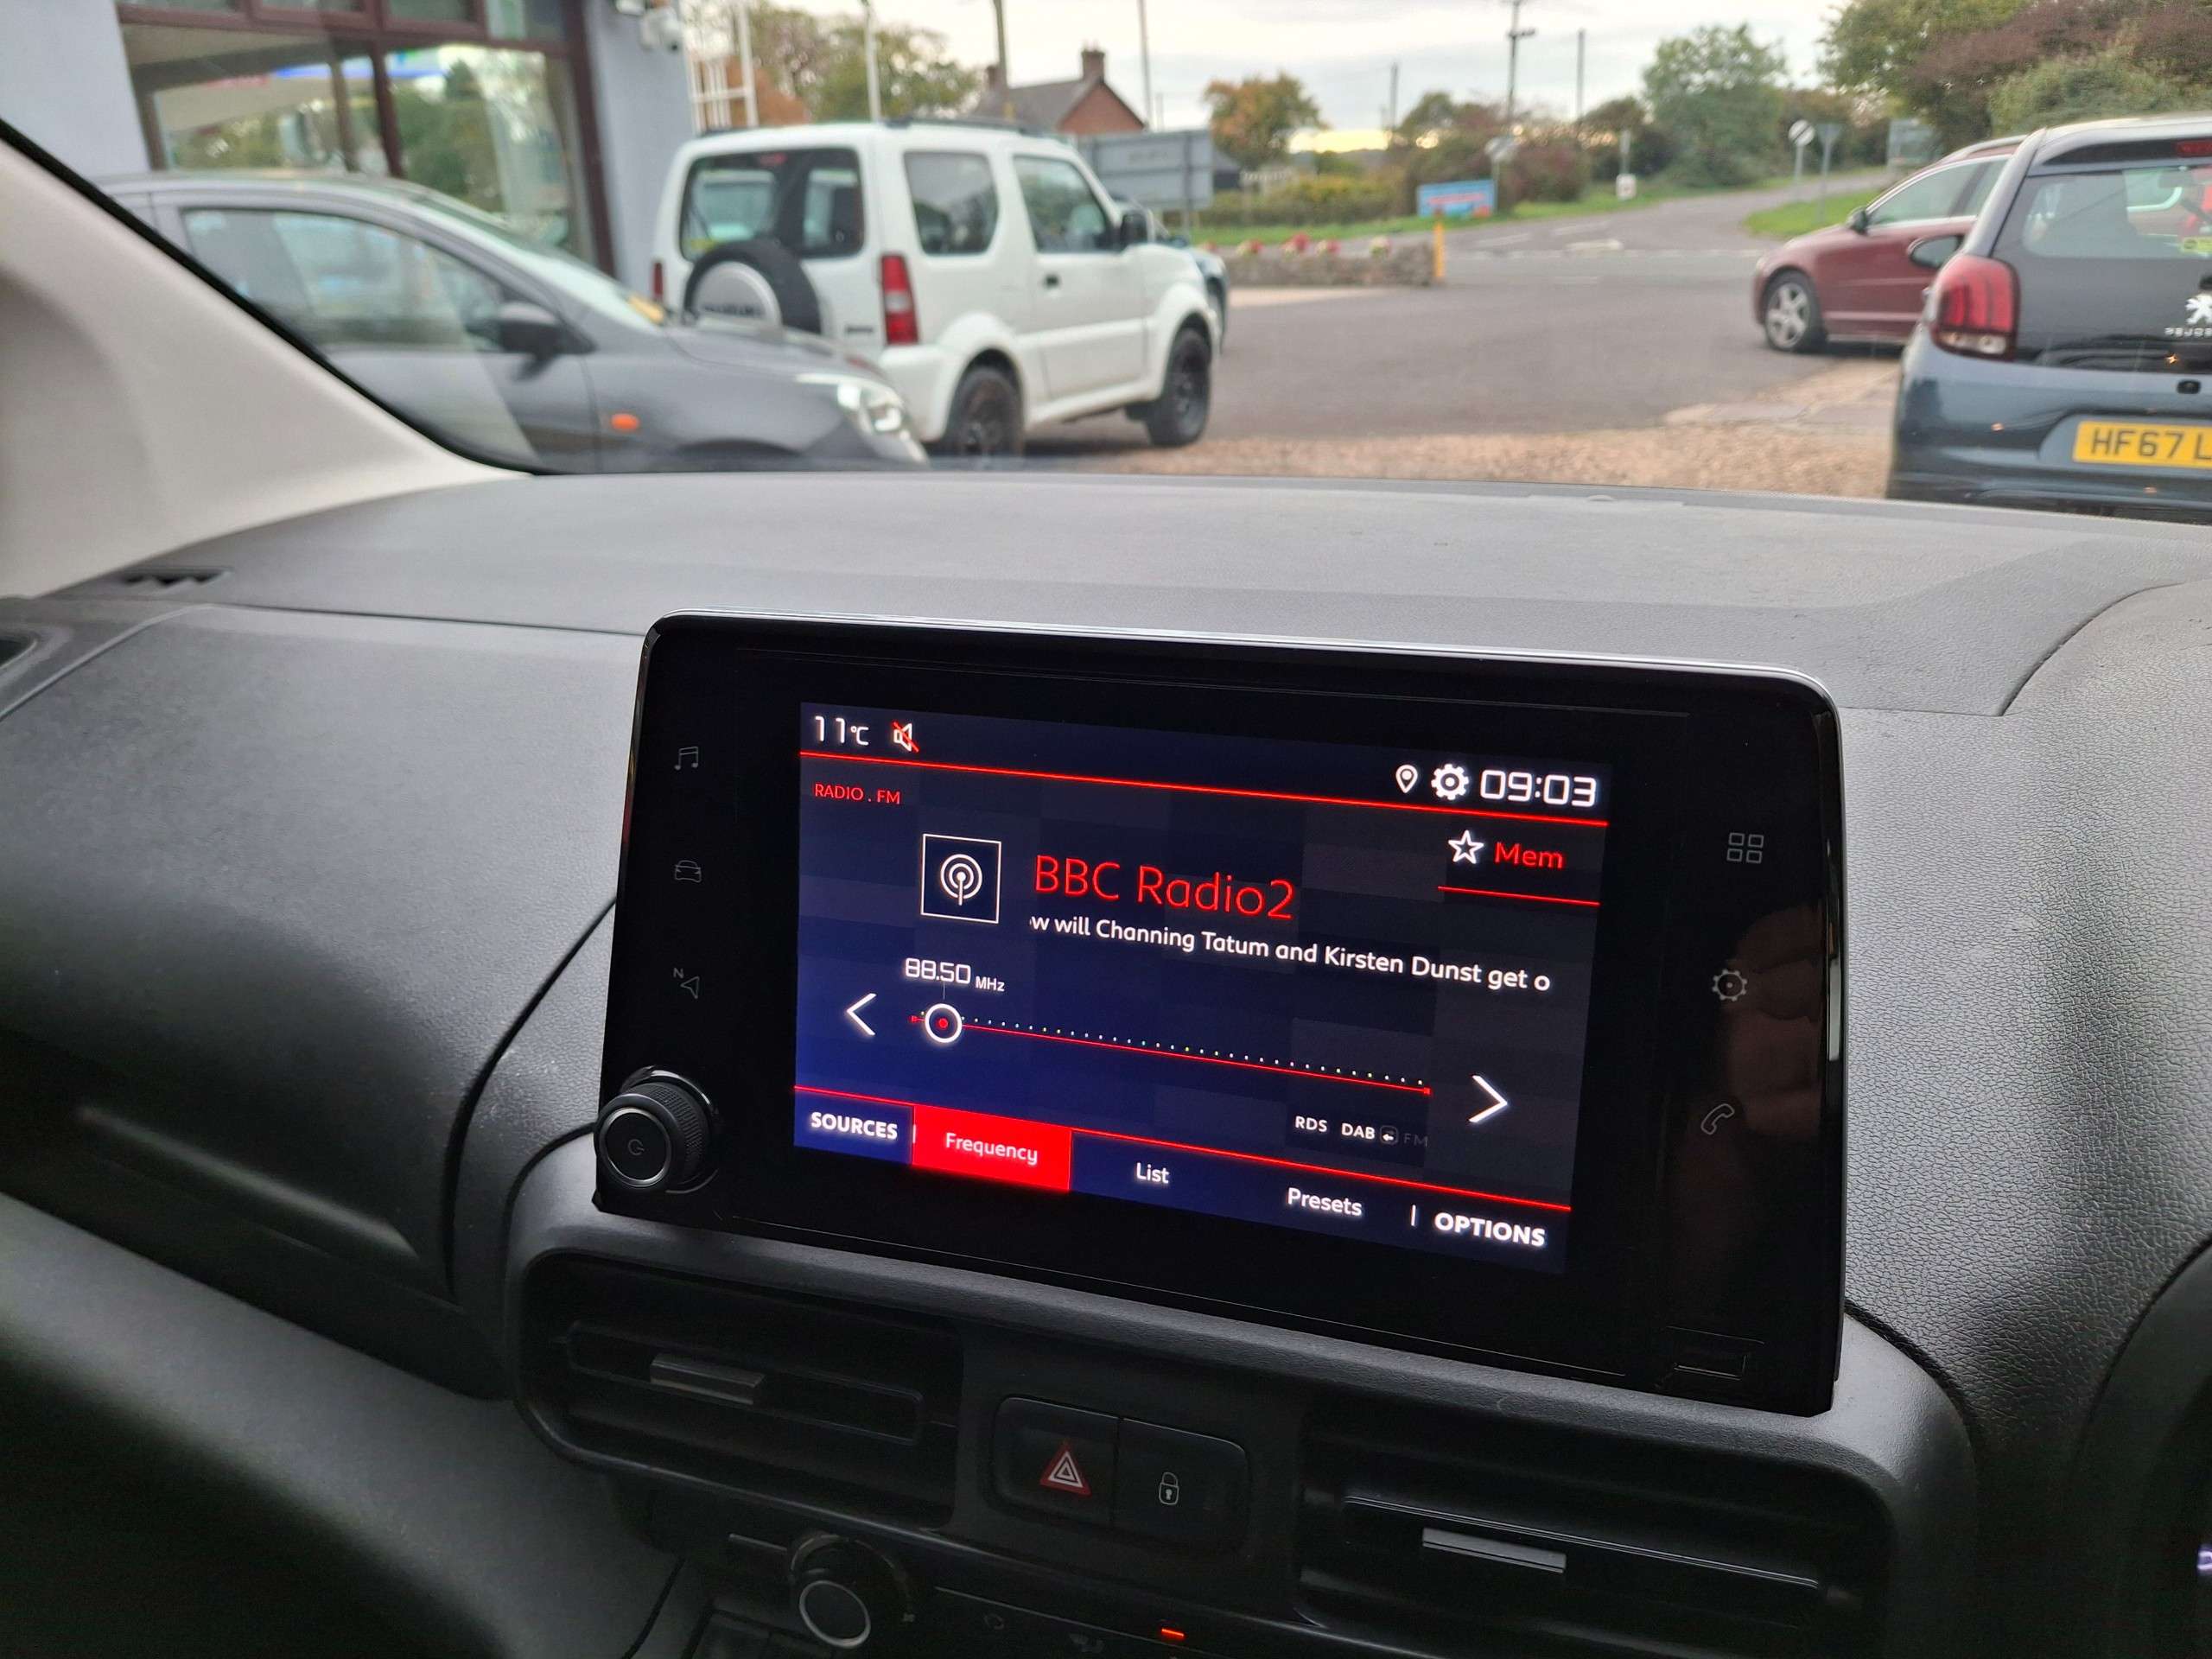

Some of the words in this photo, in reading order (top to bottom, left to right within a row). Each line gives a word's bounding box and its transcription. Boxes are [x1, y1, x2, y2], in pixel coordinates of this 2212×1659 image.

[2090, 427, 2185, 459] HF67
[814, 782, 865, 802] RADIO
[876, 789, 901, 804] FM
[1479, 768, 1598, 807] 09:03
[1494, 841, 1565, 869] Mem
[1034, 854, 1122, 900] BBC
[1136, 864, 1295, 920] Radio2
[1053, 915, 1091, 937] will
[1095, 918, 1196, 953] Channing
[1201, 931, 1269, 957] Tatum
[1274, 942, 1318, 963] and
[1324, 944, 1404, 974] Kirsten
[1411, 955, 1483, 984] Dunst
[1487, 969, 1529, 991] get
[905, 957, 972, 985] 88.50
[975, 976, 1006, 993] MHz
[810, 1110, 899, 1141] SOURCES
[1294, 1115, 1329, 1134] RDS
[1341, 1122, 1376, 1141] DAB
[1403, 1132, 1429, 1147] FM
[944, 1131, 1039, 1166] Frequency
[1135, 1161, 1170, 1185] List
[1287, 1186, 1363, 1217] Presets
[1433, 1211, 1547, 1248] OPTIONS
